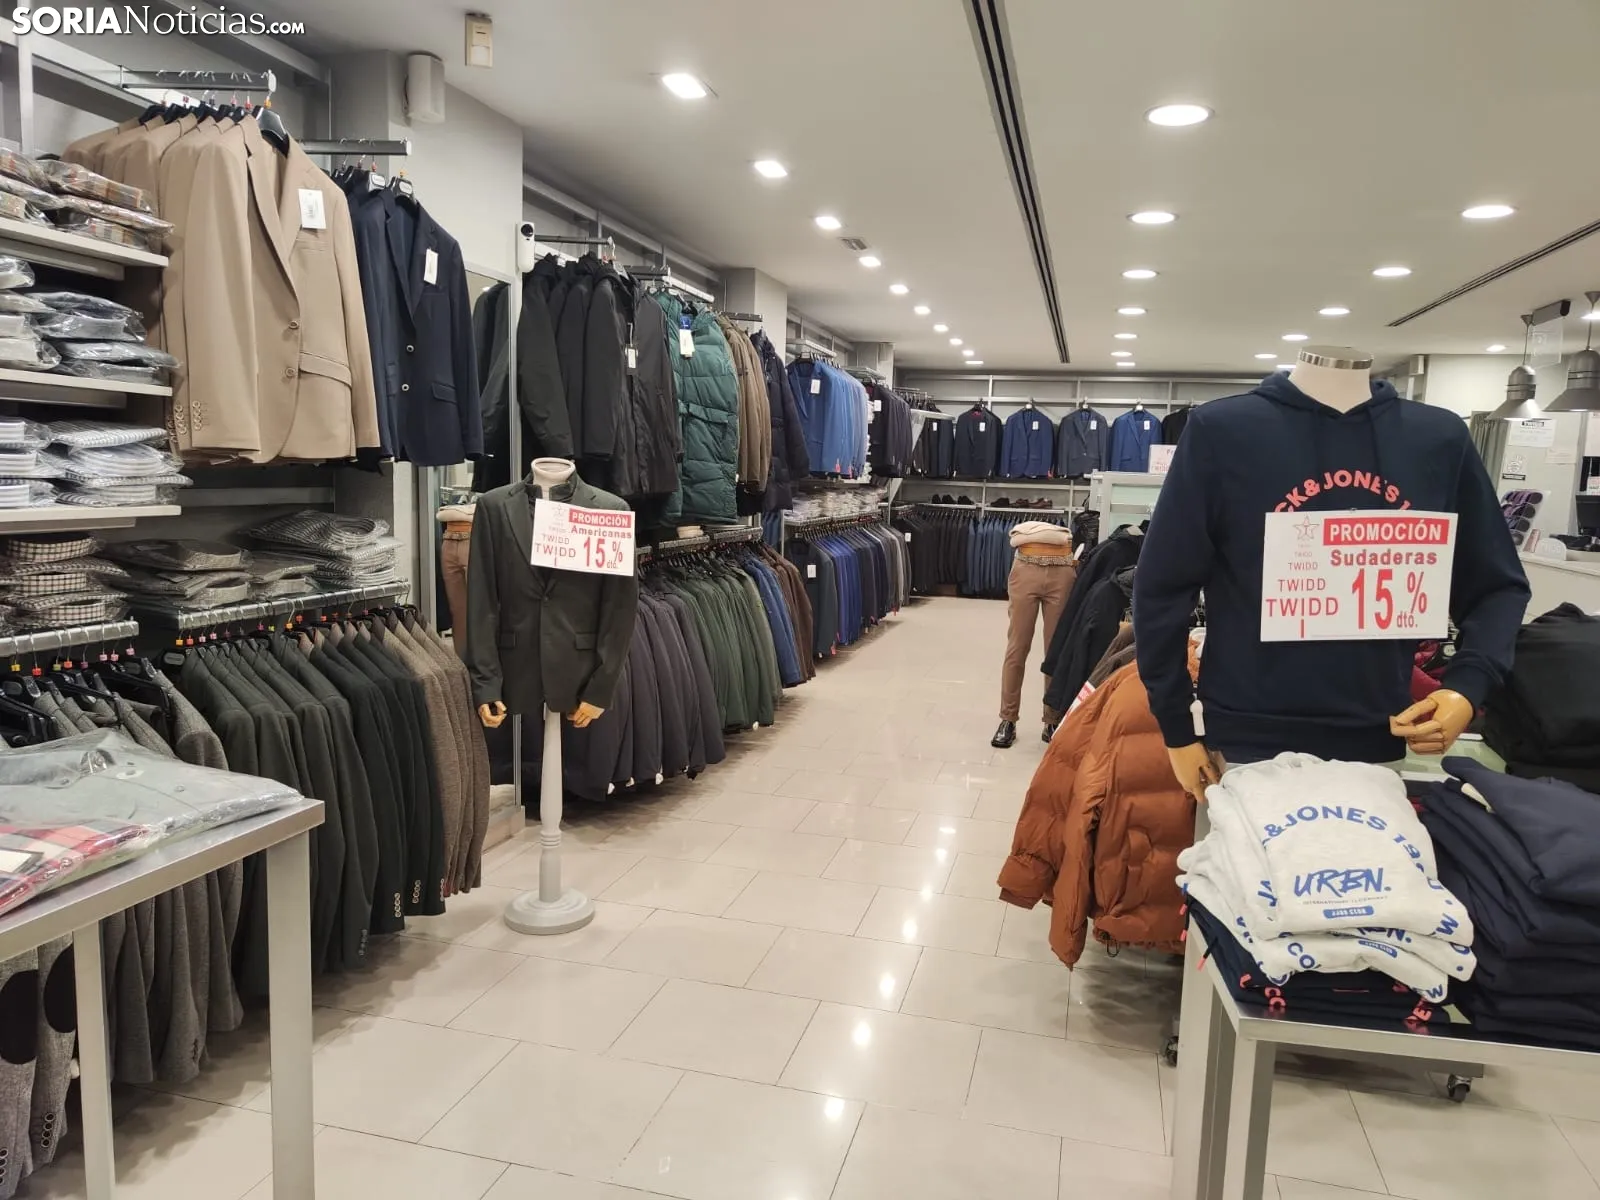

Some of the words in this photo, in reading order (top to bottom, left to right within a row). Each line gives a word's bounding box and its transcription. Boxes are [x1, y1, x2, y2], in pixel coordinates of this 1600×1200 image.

[572, 512, 629, 527] PROMOCIÓN
[570, 525, 632, 539] Americanas
[1329, 520, 1442, 542] PROMOCIÓN
[535, 542, 577, 558] TWIDD
[583, 536, 606, 568] 15
[1330, 549, 1438, 566] Sudaderas
[1287, 562, 1319, 571] TWIDD
[1277, 577, 1326, 592] TWIDD
[1265, 597, 1339, 617] TWIDD
[1351, 568, 1394, 630] 15
[1396, 613, 1419, 628] dto.
